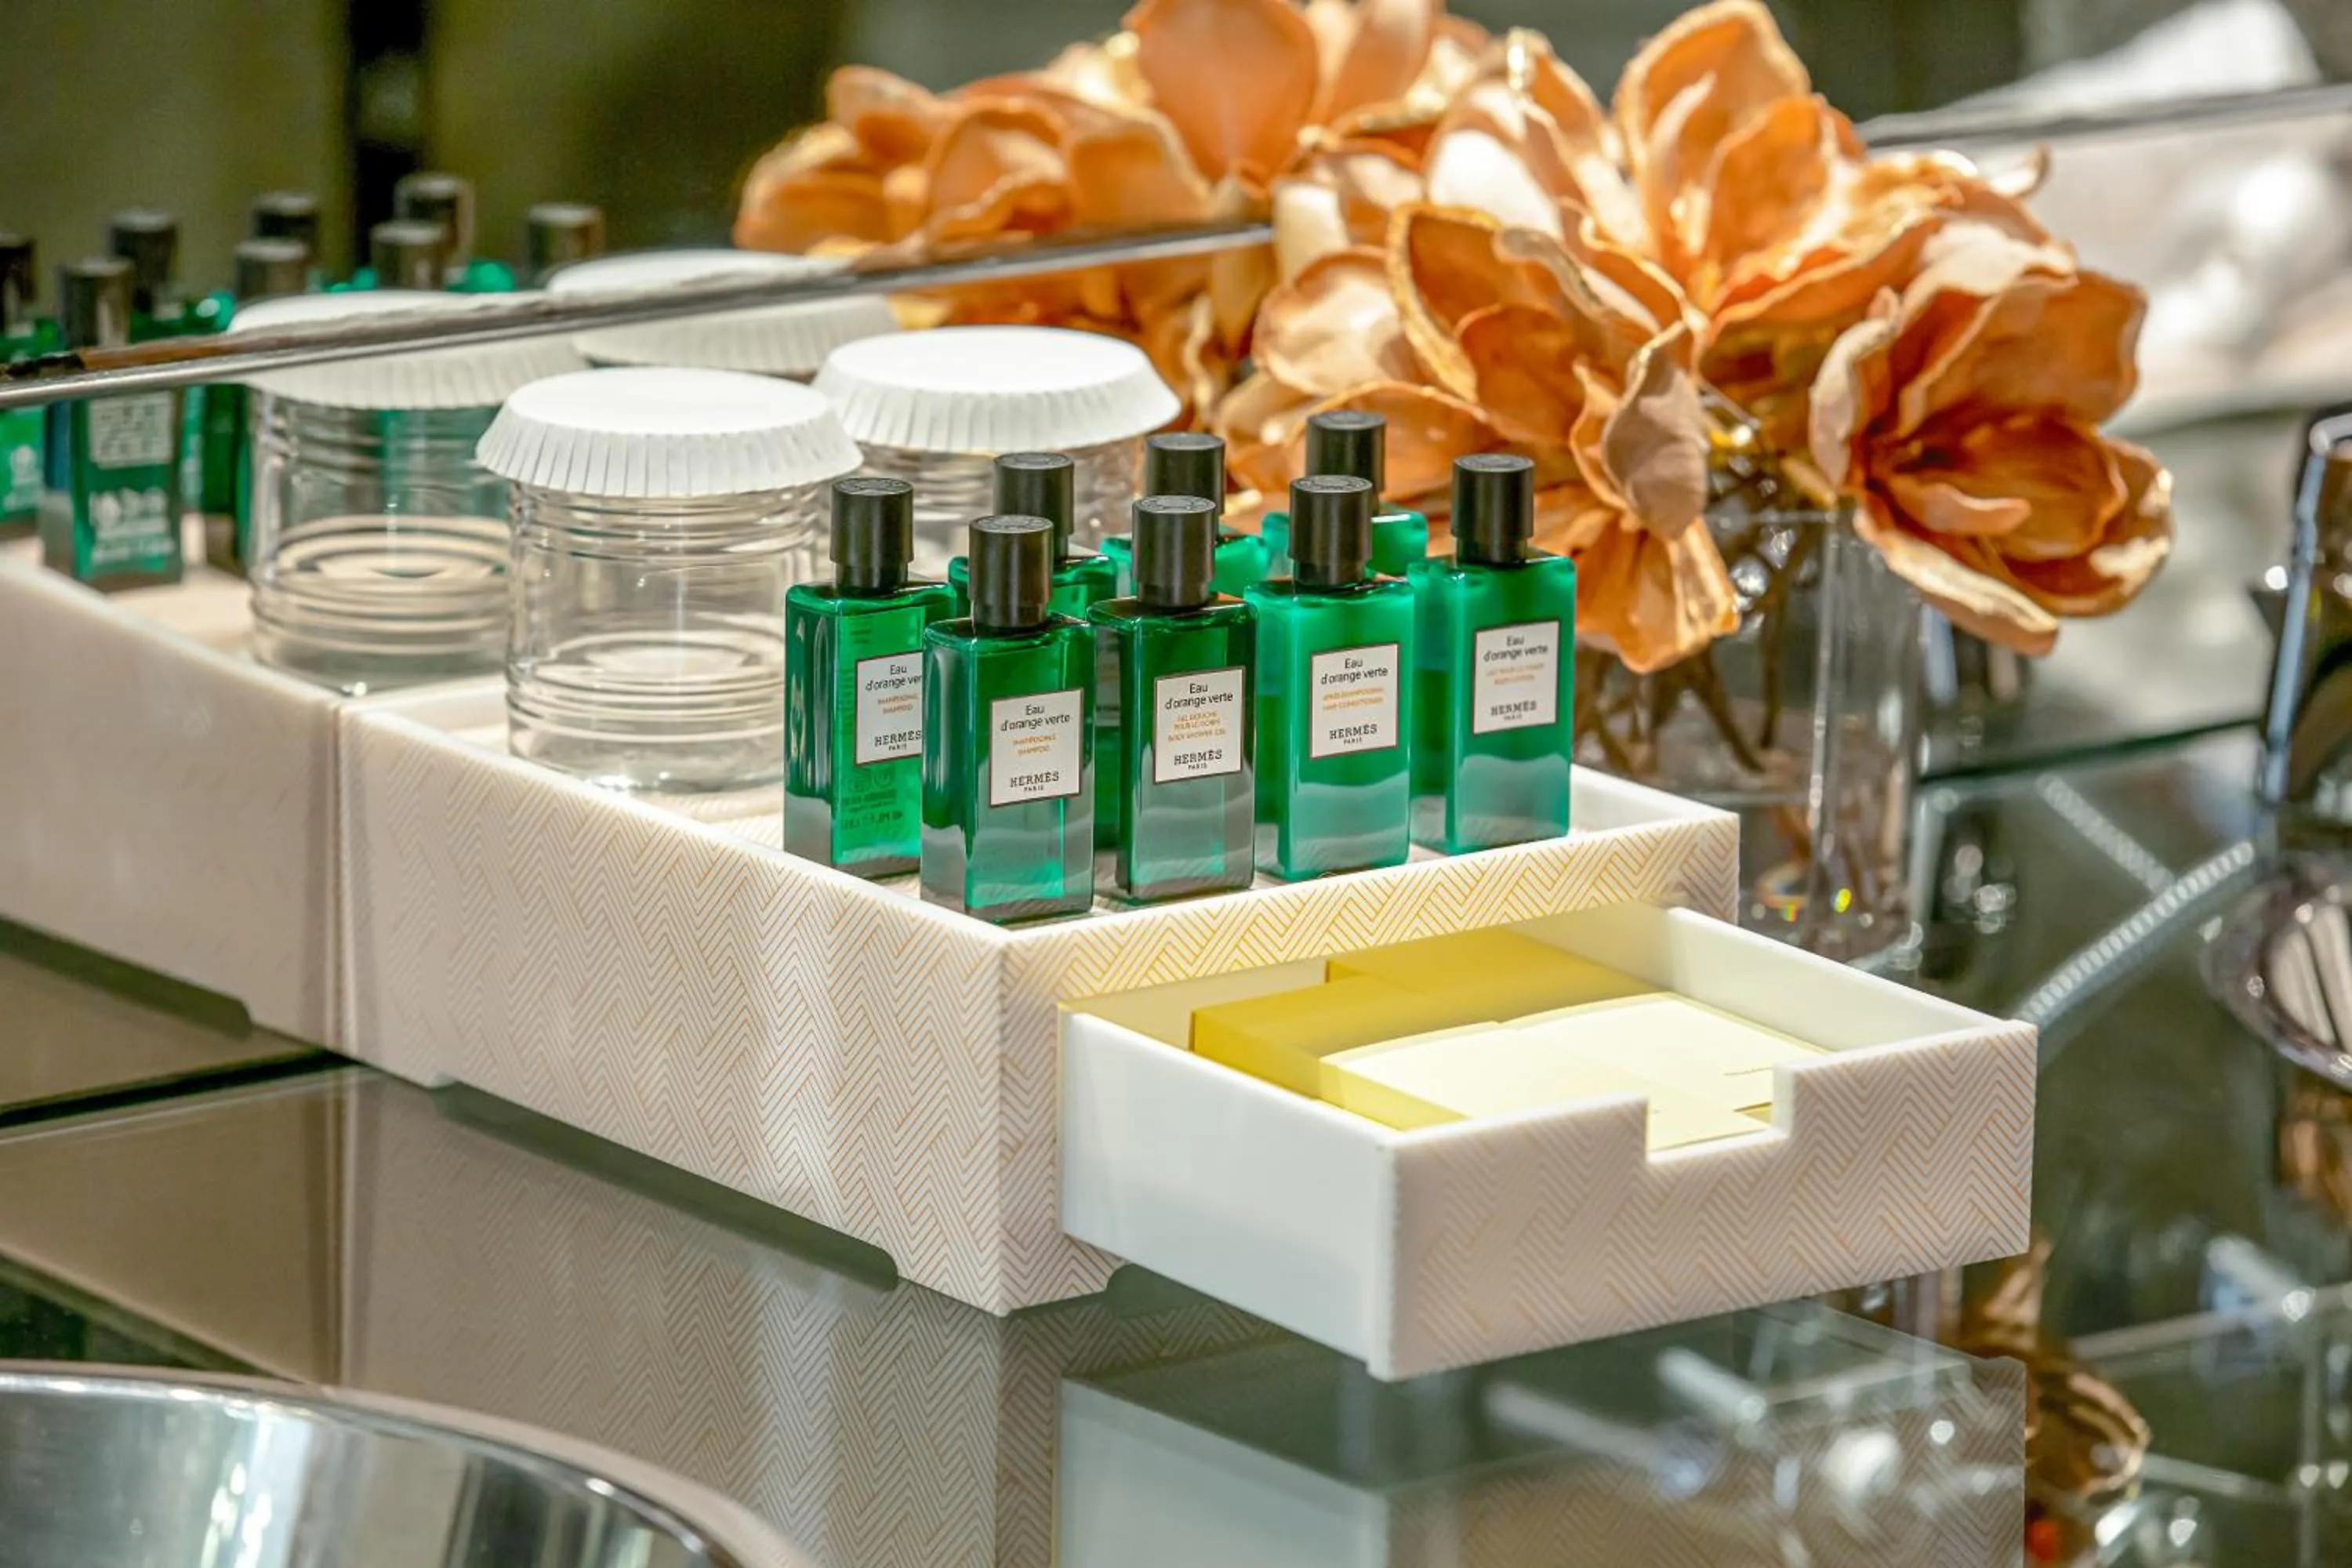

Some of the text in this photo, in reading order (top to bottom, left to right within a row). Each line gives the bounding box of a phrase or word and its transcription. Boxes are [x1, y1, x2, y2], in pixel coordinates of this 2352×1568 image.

[1506, 635, 1524, 646] Eau
[1524, 645, 1548, 656] verte
[1345, 658, 1363, 669] Eau
[890, 664, 907, 675] Eau
[1320, 667, 1388, 684] d'orange verte
[865, 675, 922, 691] d'orange ver
[1189, 683, 1208, 694] Eau
[1165, 692, 1233, 710] d'orange verte
[1025, 705, 1044, 715] Eau
[1000, 713, 1070, 731] d'orange verte
